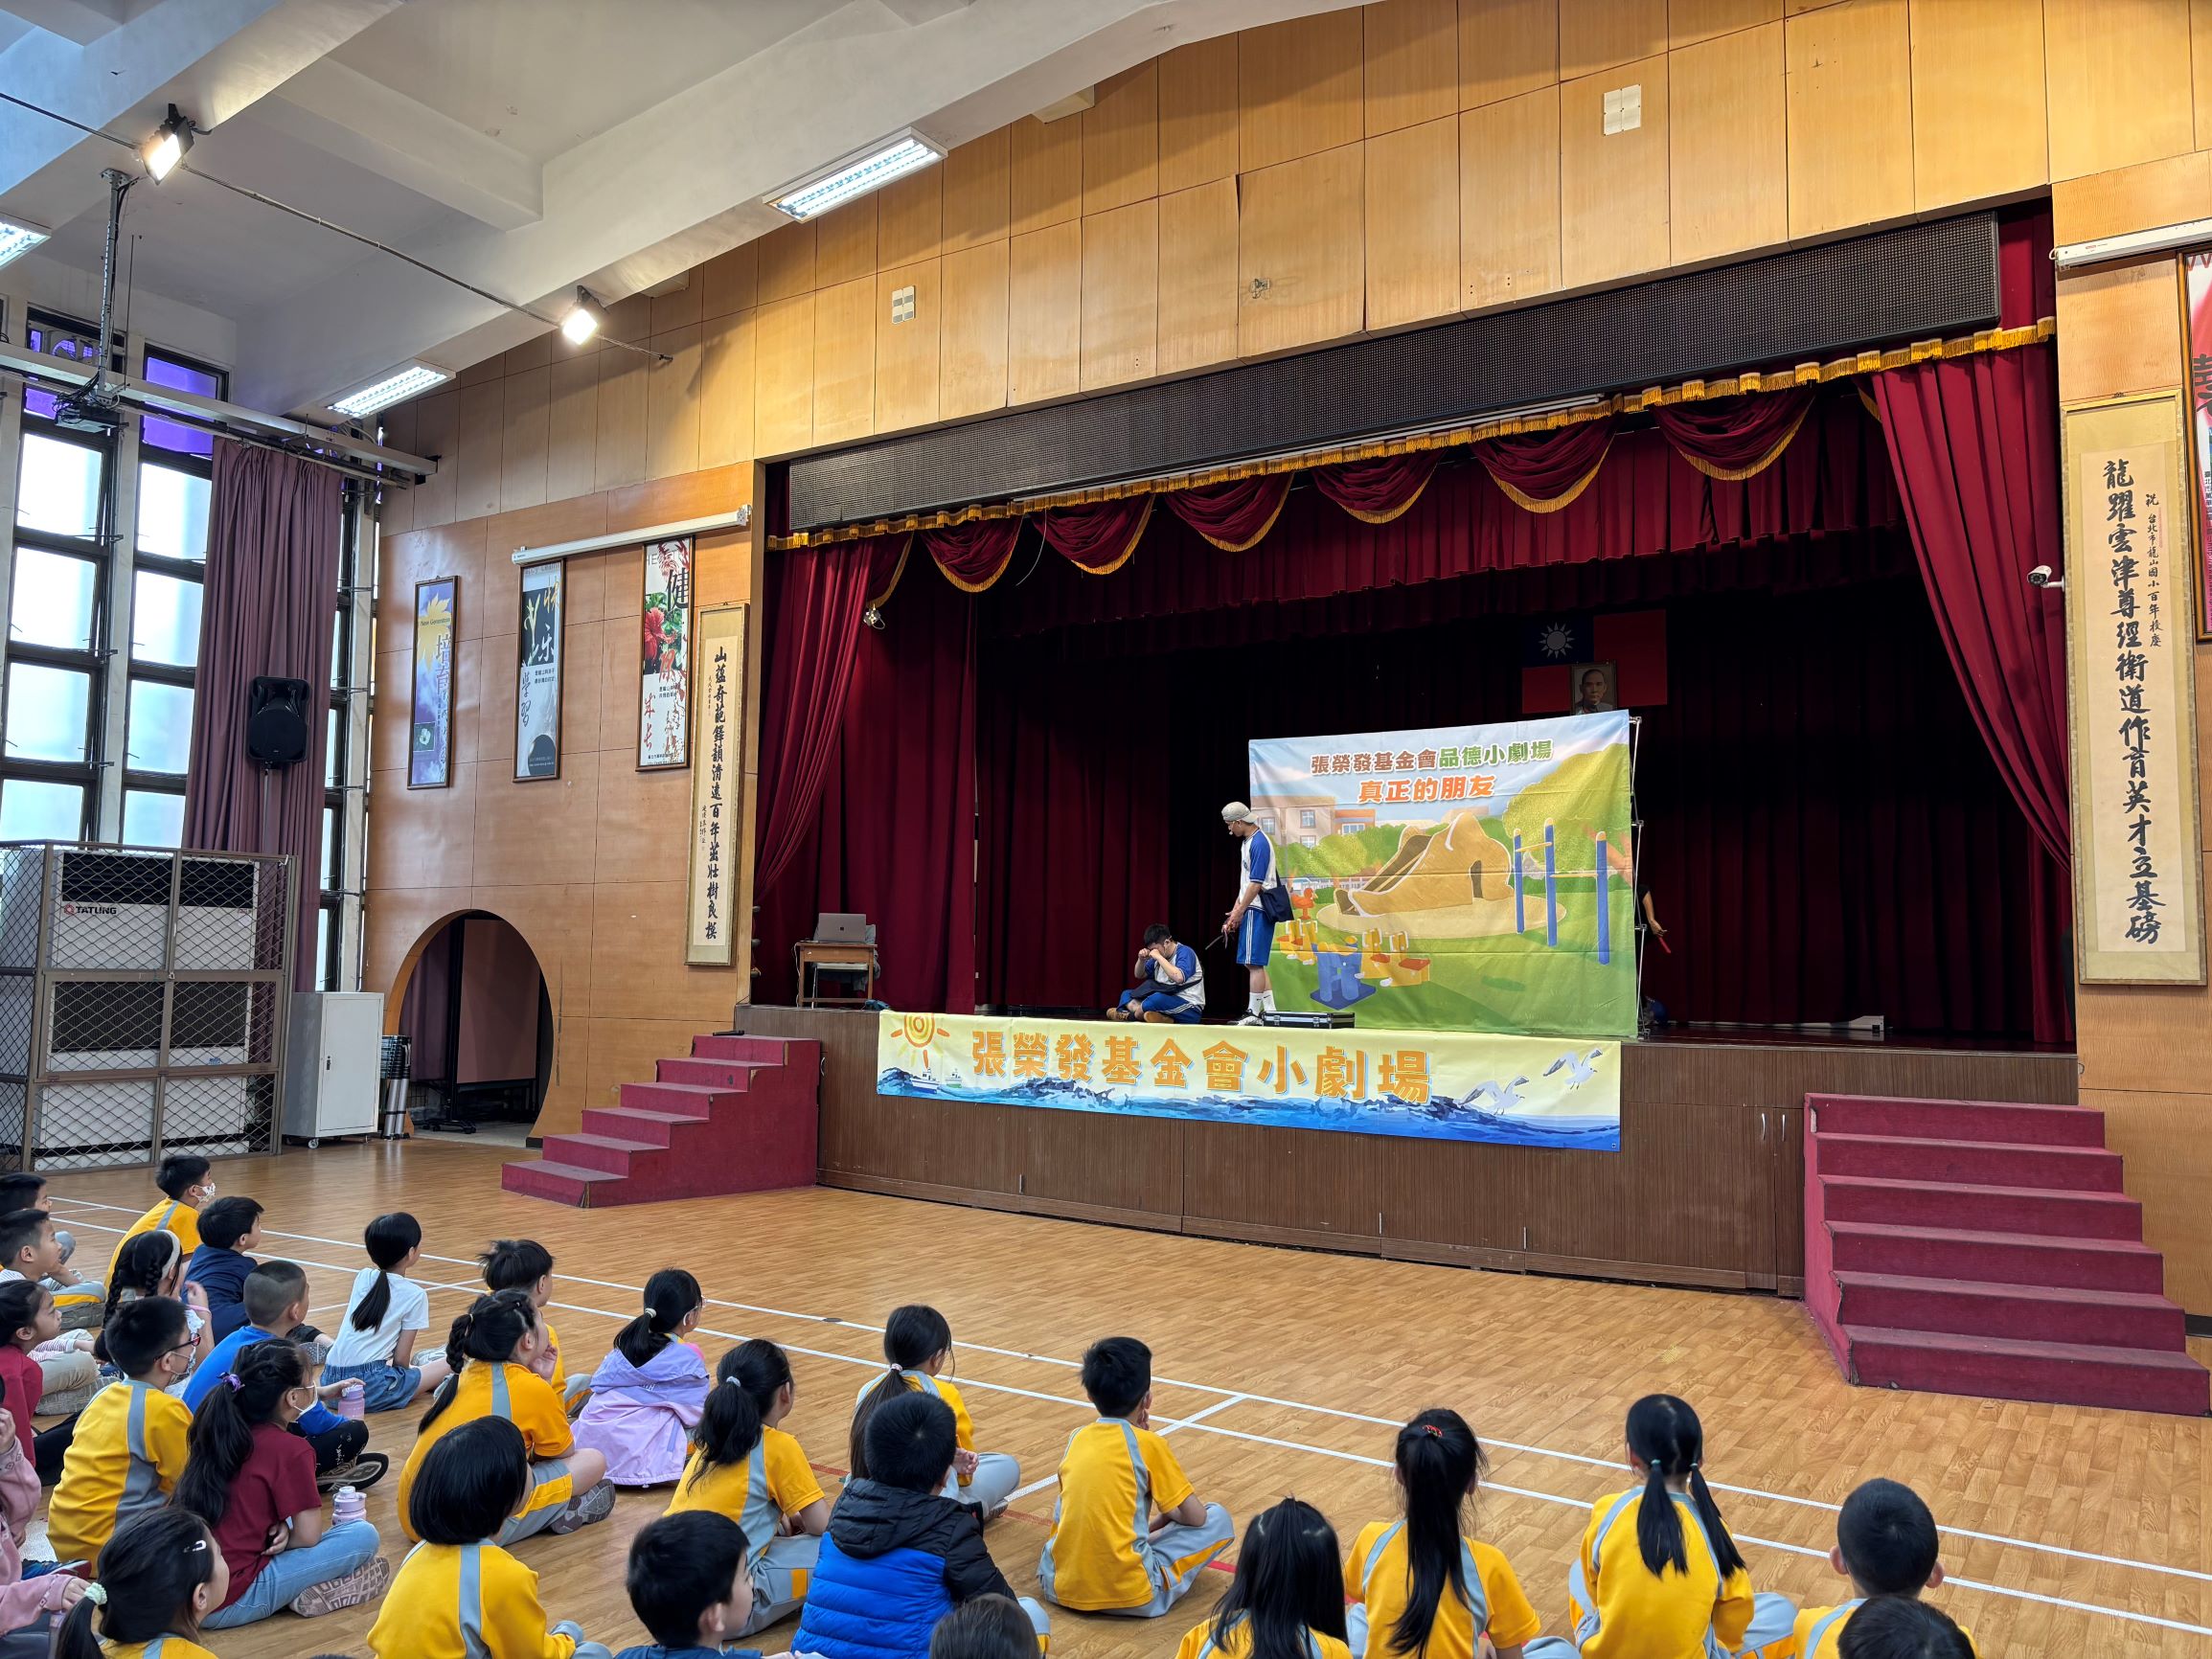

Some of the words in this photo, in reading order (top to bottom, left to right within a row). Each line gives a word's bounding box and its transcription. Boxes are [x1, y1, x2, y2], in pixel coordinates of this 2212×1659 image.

[1311, 739, 1553, 774] 張榮發基金會品德小劇場
[1358, 774, 1496, 804] 真正的朋友
[76, 905, 117, 915] TATUNG
[972, 1030, 1432, 1103] 張榮發基金會小劇場
